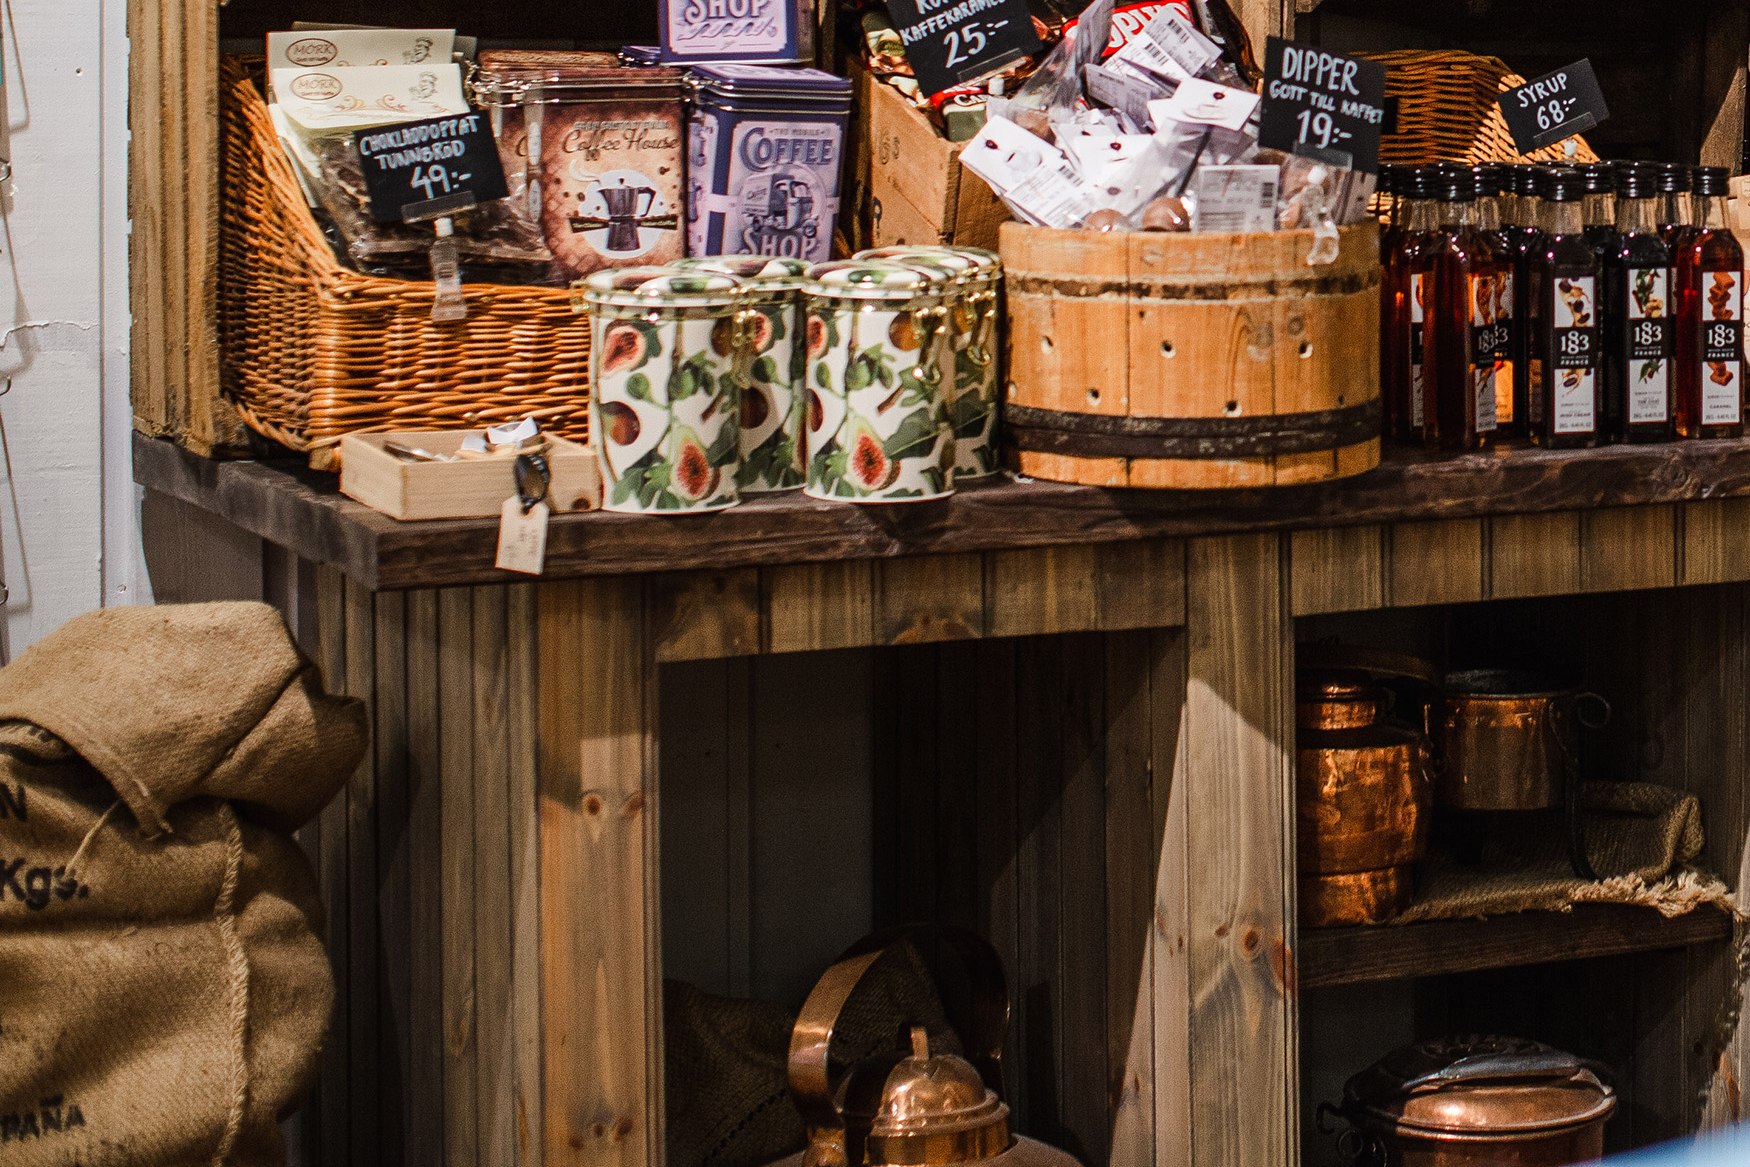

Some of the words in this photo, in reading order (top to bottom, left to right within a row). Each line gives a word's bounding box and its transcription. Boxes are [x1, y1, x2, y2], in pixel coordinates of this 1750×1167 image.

[1281, 46, 1360, 96] DIPPER
[1517, 72, 1568, 108] SYRUP
[1269, 79, 1309, 101] GOTT
[1310, 91, 1336, 111] TILL
[1340, 99, 1384, 124] KAFFET
[359, 115, 480, 156] CHOKLADDOPPAT
[374, 139, 466, 170] TUNNBRÖD
[561, 128, 620, 161] Coffee
[625, 130, 681, 153] House
[740, 126, 834, 172] COFFEE
[739, 226, 818, 260] SHOP
